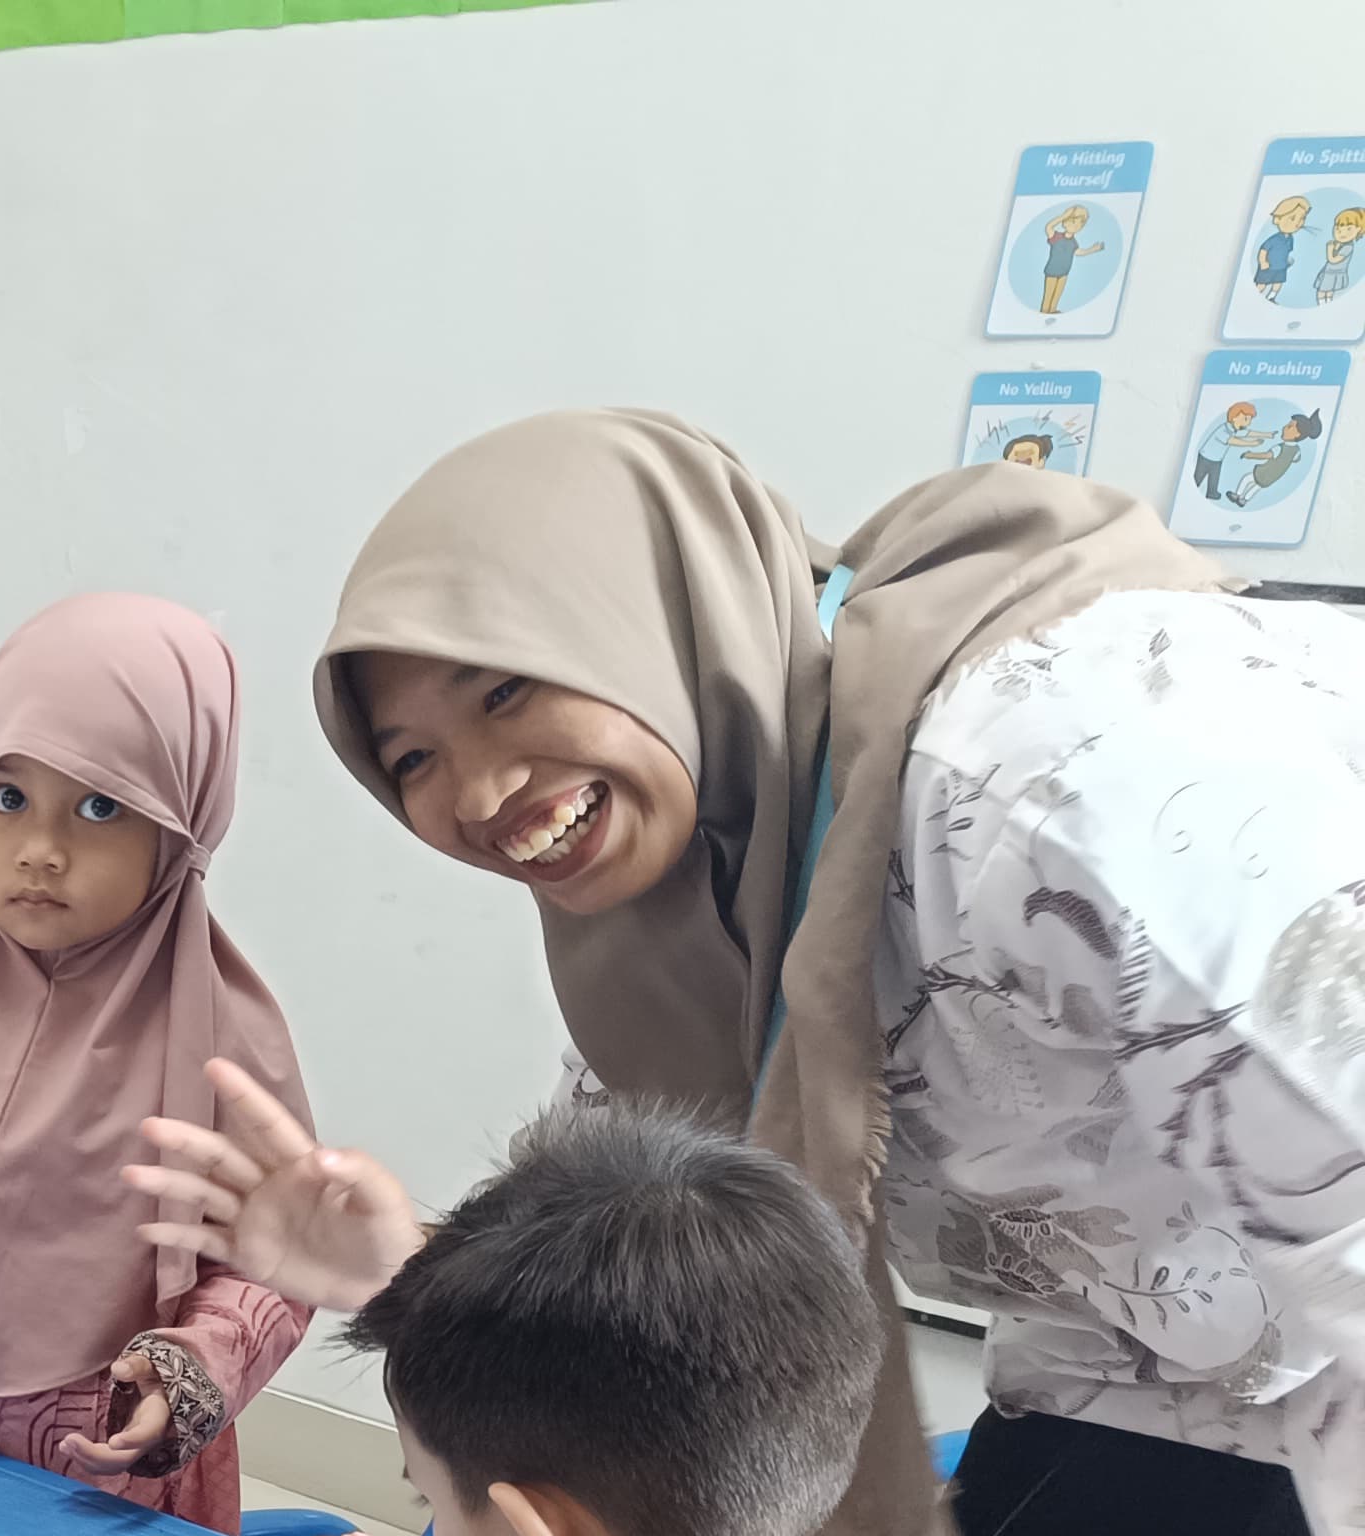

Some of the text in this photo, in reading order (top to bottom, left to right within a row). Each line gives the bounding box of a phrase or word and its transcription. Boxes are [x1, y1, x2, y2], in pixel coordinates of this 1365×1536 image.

[1046, 150, 1126, 168] No Hitting
[1291, 149, 1315, 165] No
[1053, 170, 1114, 190] Yourself
[1229, 361, 1323, 379] No Pushing
[999, 382, 1073, 400] No Yelling
